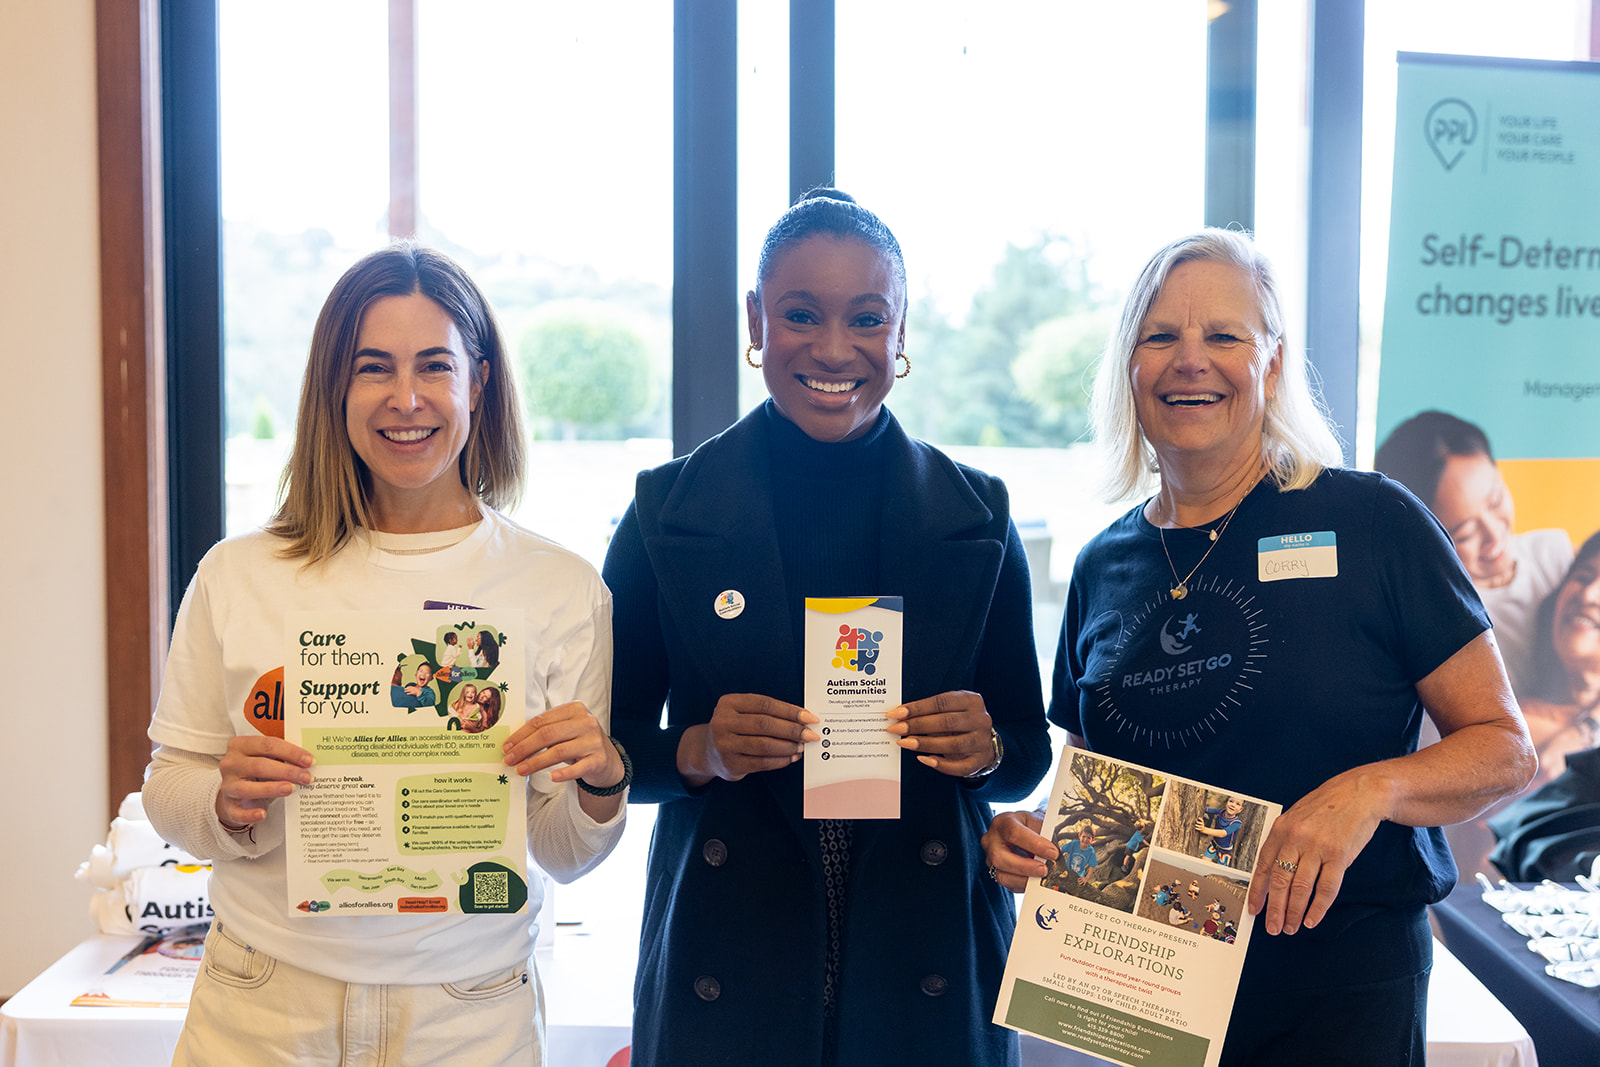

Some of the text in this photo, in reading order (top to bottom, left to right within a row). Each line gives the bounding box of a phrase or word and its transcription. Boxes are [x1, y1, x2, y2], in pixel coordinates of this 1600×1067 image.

[1416, 282, 1548, 324] changes
[1280, 534, 1312, 544] HELLO
[299, 630, 346, 646] Care
[300, 648, 384, 666] for them.
[1122, 654, 1232, 688] READY SET GO
[300, 680, 380, 700] Support
[827, 687, 887, 695] Communities
[860, 678, 886, 686] Social
[1150, 678, 1202, 695] THERAPY
[300, 697, 368, 718] for you.
[1069, 904, 1199, 948] READY SET GO THERAPY PRESENTS:
[1083, 923, 1176, 960] FRIENDSHIP
[1063, 934, 1184, 980] EXPLORATIONS
[1053, 972, 1066, 981] LED
[1079, 980, 1090, 988] AN
[1114, 991, 1140, 1005] SPEECH
[1072, 957, 1095, 968] outdoor
[1095, 965, 1115, 976] camps
[1116, 970, 1128, 979] and
[1128, 975, 1160, 989] year-round
[1160, 985, 1181, 996] groups
[1085, 970, 1098, 978] with
[1104, 975, 1137, 991] therapeutic
[1138, 986, 1153, 995] twist
[1042, 976, 1065, 988] SMALL
[1097, 995, 1114, 1003] LOW
[1115, 1000, 1164, 1020] CHILD-ADULT
[1165, 1016, 1188, 1027] RATIO
[1058, 1020, 1151, 1055] www.friendshipexplorations.com
[1077, 1005, 1089, 1014] find
[1106, 1014, 1136, 1030] Friendship
[1137, 1025, 1174, 1041] Explorations
[1083, 1015, 1098, 1024] right
[1107, 1022, 1121, 1031] your
[1062, 1029, 1143, 1060] www.readysetgotherapy.com
